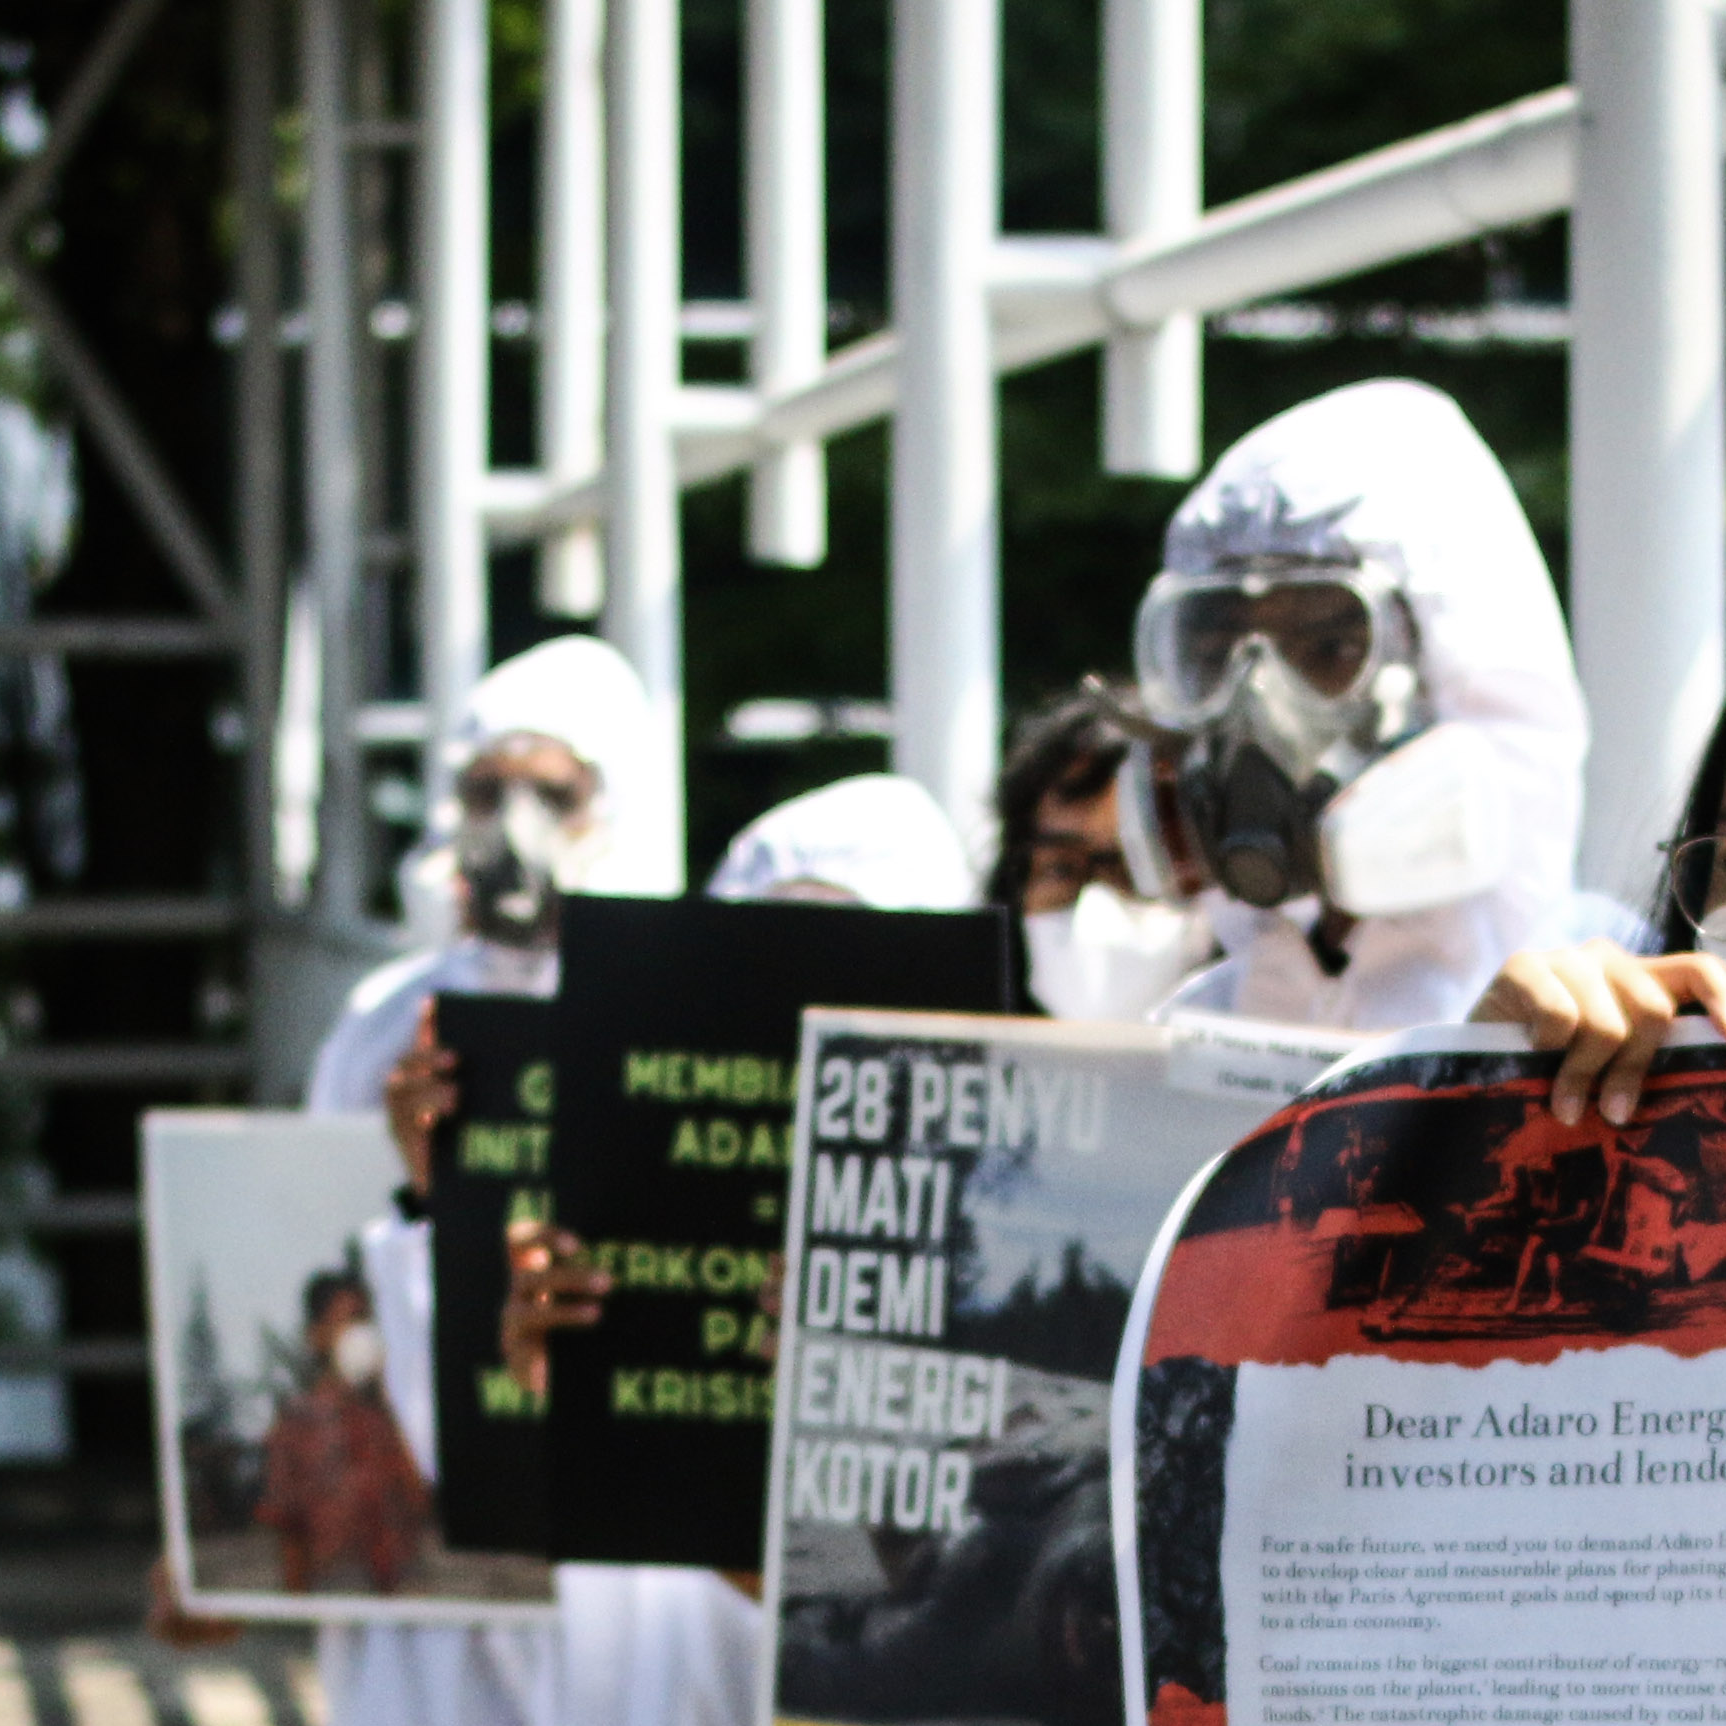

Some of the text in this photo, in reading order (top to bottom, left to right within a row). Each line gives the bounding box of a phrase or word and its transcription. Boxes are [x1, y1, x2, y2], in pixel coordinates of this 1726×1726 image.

[819, 1057, 1104, 1151] 28 PENYU
[814, 1153, 951, 1243] MATI
[807, 1249, 946, 1339] DEMI
[798, 1343, 1008, 1439] ENERGI
[1365, 1403, 1461, 1439] Dear
[1473, 1403, 1598, 1438] Adaro
[790, 1439, 982, 1531] KOTOR.
[1345, 1455, 1535, 1488] investors
[1549, 1453, 1622, 1486] and
[1261, 1536, 1295, 1552] For
[1300, 1542, 1310, 1552] a
[1315, 1537, 1354, 1552] safe
[1433, 1540, 1458, 1552] we
[1464, 1536, 1507, 1552] need
[1513, 1540, 1547, 1556] you
[1554, 1536, 1572, 1551] to
[1578, 1534, 1652, 1550] demand
[1659, 1533, 1713, 1550] Adaro
[1261, 1565, 1279, 1578] to
[1286, 1563, 1358, 1582] develop
[1365, 1563, 1407, 1578] clear
[1415, 1562, 1448, 1577] and
[1454, 1560, 1561, 1577] measurable
[1566, 1560, 1616, 1580] plans
[1624, 1560, 1650, 1577] for
[1657, 1558, 1726, 1578] phasing
[1261, 1588, 1306, 1604] with
[1350, 1588, 1395, 1603] Paris
[1403, 1587, 1504, 1606] Agreement
[1511, 1586, 1557, 1606] goals
[1564, 1586, 1599, 1602] and
[1605, 1586, 1655, 1606] speed
[1662, 1589, 1683, 1605] up
[1690, 1585, 1712, 1601] its
[1261, 1615, 1279, 1629] to
[1285, 1618, 1294, 1629] a
[1300, 1613, 1347, 1629] clean
[1259, 1655, 1300, 1671] Coal
[1306, 1657, 1381, 1671] remains
[1387, 1655, 1416, 1671] the
[1422, 1655, 1488, 1675] biggest
[1494, 1654, 1607, 1671] contributor
[1614, 1653, 1636, 1669] of
[1261, 1682, 1348, 1697] emissions
[1353, 1685, 1375, 1696] on
[1382, 1681, 1411, 1696] the
[1492, 1679, 1559, 1698] leading
[1567, 1681, 1585, 1695] to
[1592, 1684, 1639, 1695] more
[1647, 1679, 1715, 1695] intense
[1331, 1705, 1364, 1721] The
[1371, 1705, 1485, 1725] catastrophic
[1493, 1705, 1563, 1725] damage
[1569, 1704, 1632, 1721] caused
[1639, 1705, 1659, 1724] by
[1668, 1704, 1704, 1720] coal
